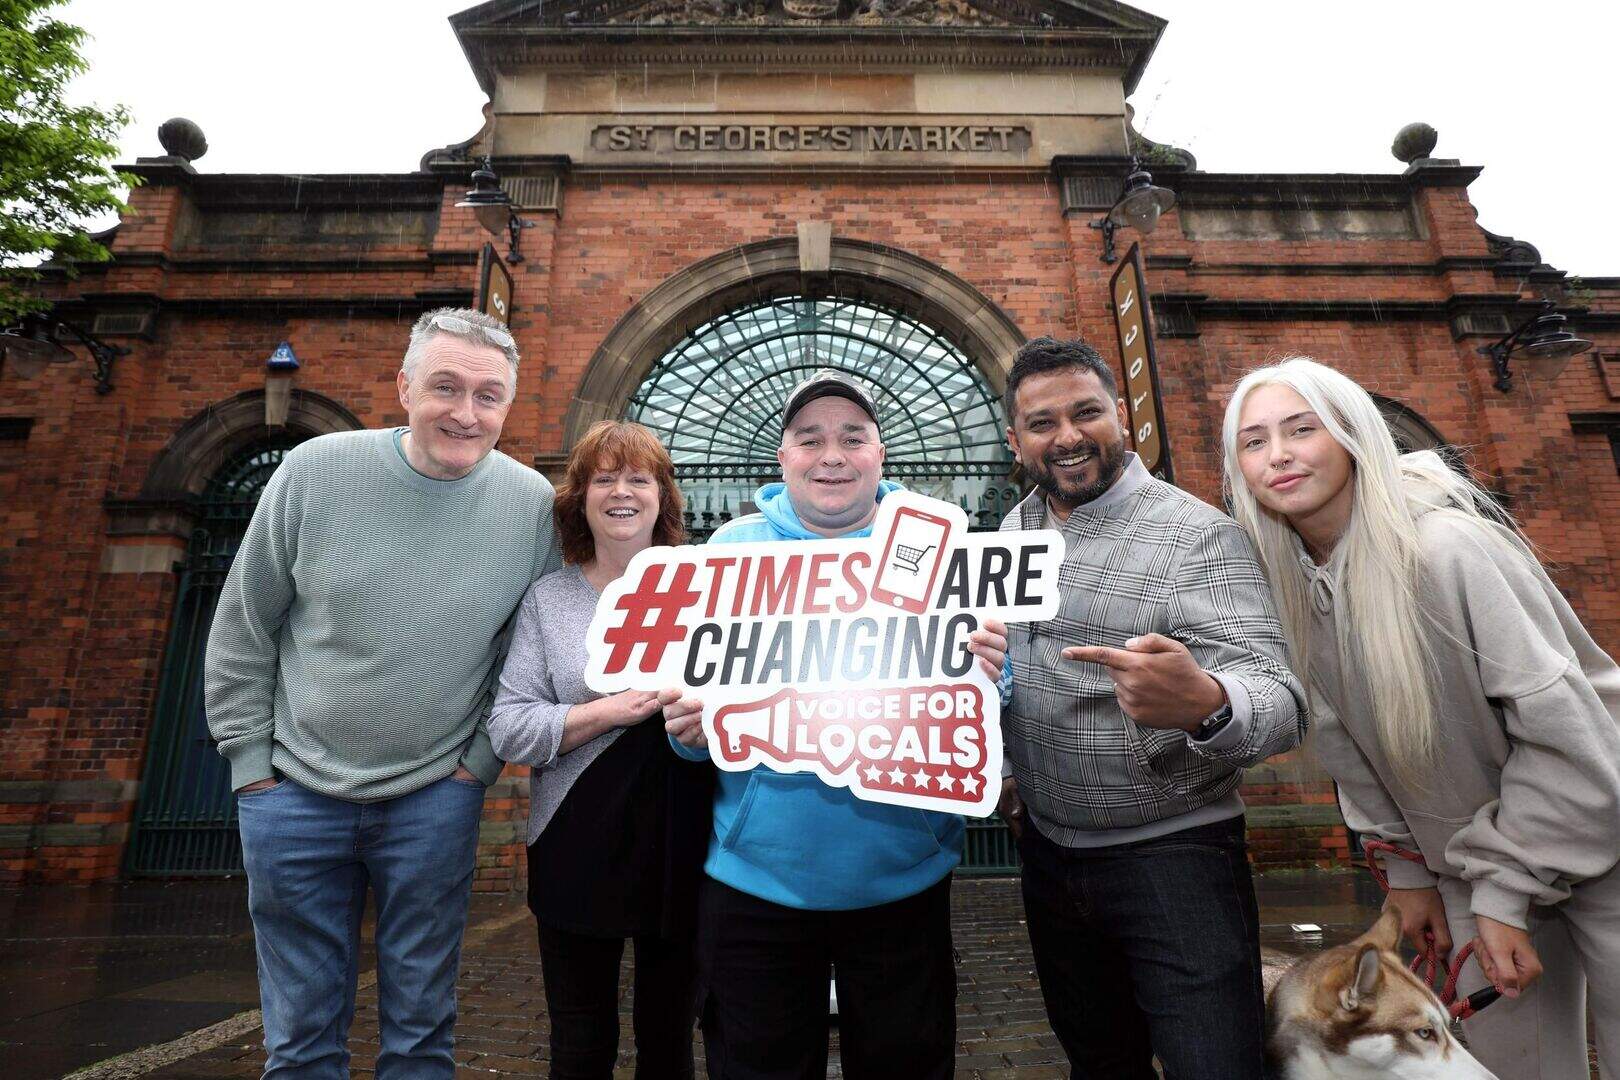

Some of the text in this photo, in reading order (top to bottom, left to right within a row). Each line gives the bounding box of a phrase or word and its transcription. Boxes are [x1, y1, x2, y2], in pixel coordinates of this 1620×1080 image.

[674, 126, 851, 151] GEORGE'S
[868, 126, 1014, 151] MARKET
[1119, 289, 1152, 443] STOCK
[936, 544, 1049, 609] ARE
[683, 612, 979, 688] CHANGING
[795, 690, 977, 720] VOICE FOR
[795, 724, 981, 769] LOCALS
